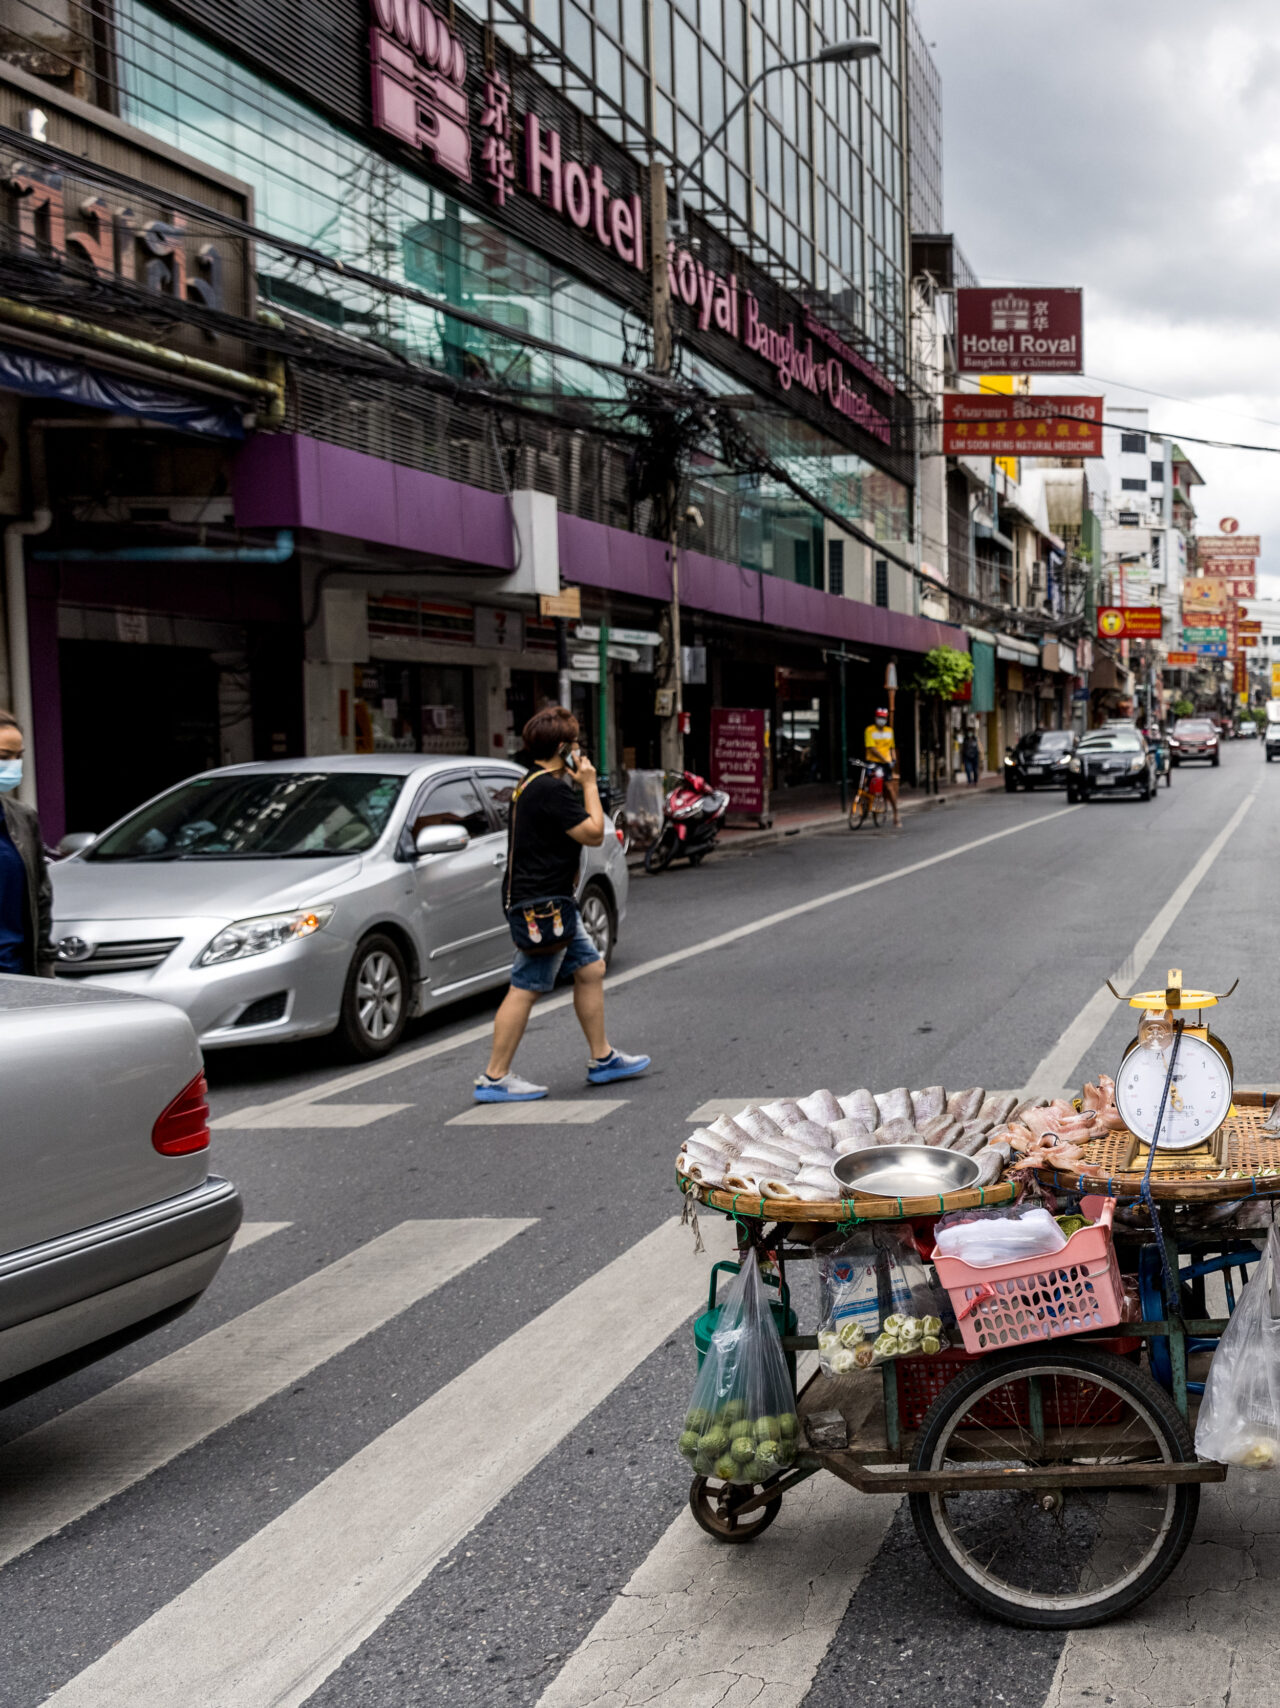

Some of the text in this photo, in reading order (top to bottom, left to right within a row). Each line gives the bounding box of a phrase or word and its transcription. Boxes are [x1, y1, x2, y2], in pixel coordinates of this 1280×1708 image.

[525, 112, 643, 271] Hotel
[745, 291, 818, 393] Bangkok
[1033, 301, 1048, 332] 京华
[962, 335, 1077, 355] Hotel Royal
[963, 356, 1007, 368] Bangkok
[1022, 356, 1077, 368] Chinatown
[950, 439, 1096, 451] LIM SOON HENG NATURAL MEDICINE
[718, 738, 757, 749] Parking
[714, 748, 760, 758] Entrance
[1156, 1052, 1161, 1060] 7
[1202, 1061, 1206, 1069] 1
[1210, 1091, 1217, 1099] 2
[1136, 1108, 1142, 1116] 5
